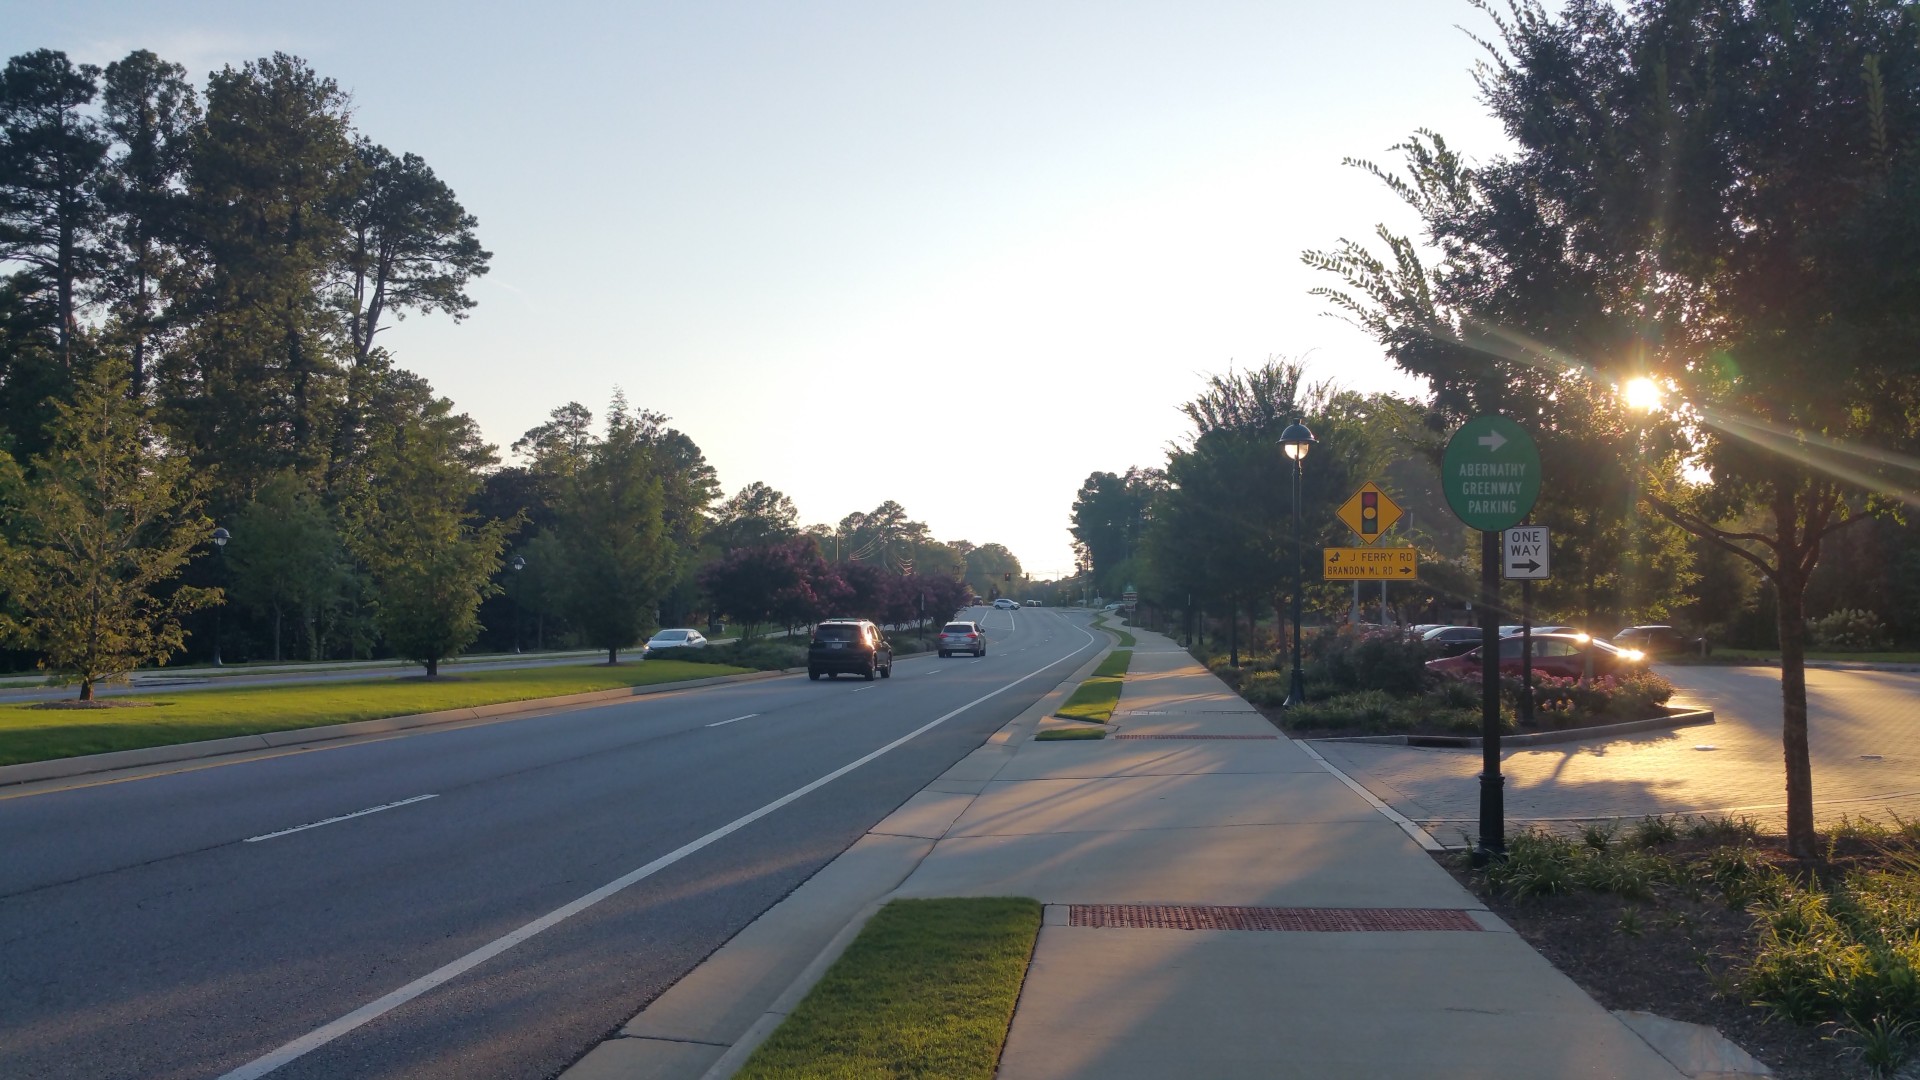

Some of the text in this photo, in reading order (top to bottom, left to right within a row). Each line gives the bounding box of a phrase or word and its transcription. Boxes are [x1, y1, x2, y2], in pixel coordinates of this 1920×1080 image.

[1459, 463, 1526, 477] ABERNATHY
[1462, 482, 1522, 495] GREENWAY
[1468, 500, 1516, 513] PARKING
[1511, 531, 1540, 543] ONE
[1510, 545, 1541, 556] WAY
[1350, 552, 1413, 562] J FERRY RD
[1327, 566, 1365, 575] BRANDON
[1382, 566, 1393, 575] RD
